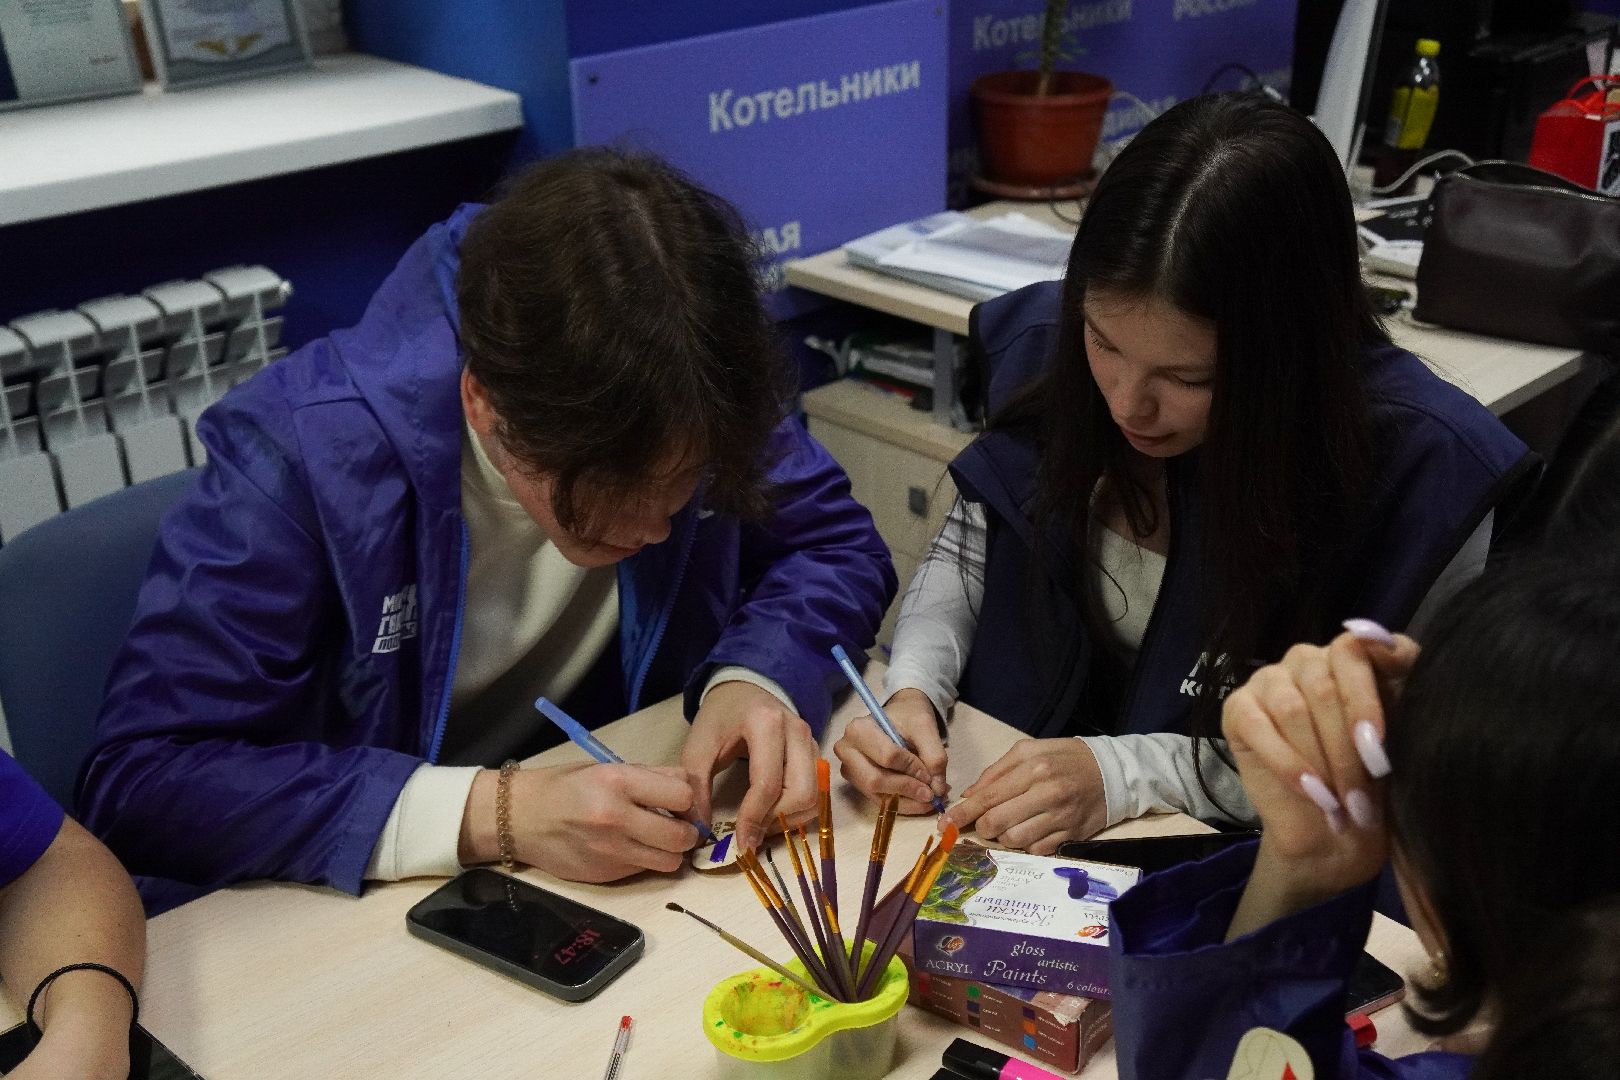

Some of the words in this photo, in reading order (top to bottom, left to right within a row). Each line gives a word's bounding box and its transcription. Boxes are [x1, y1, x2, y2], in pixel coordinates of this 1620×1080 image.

[972, 0, 1133, 50] Котеьники
[708, 60, 921, 133] Котельники
[1010, 940, 1046, 957] gloss
[926, 959, 973, 975] ACRYL
[983, 960, 1048, 985] Paints
[1037, 959, 1080, 972] artistic
[1066, 981, 1074, 990] 6
